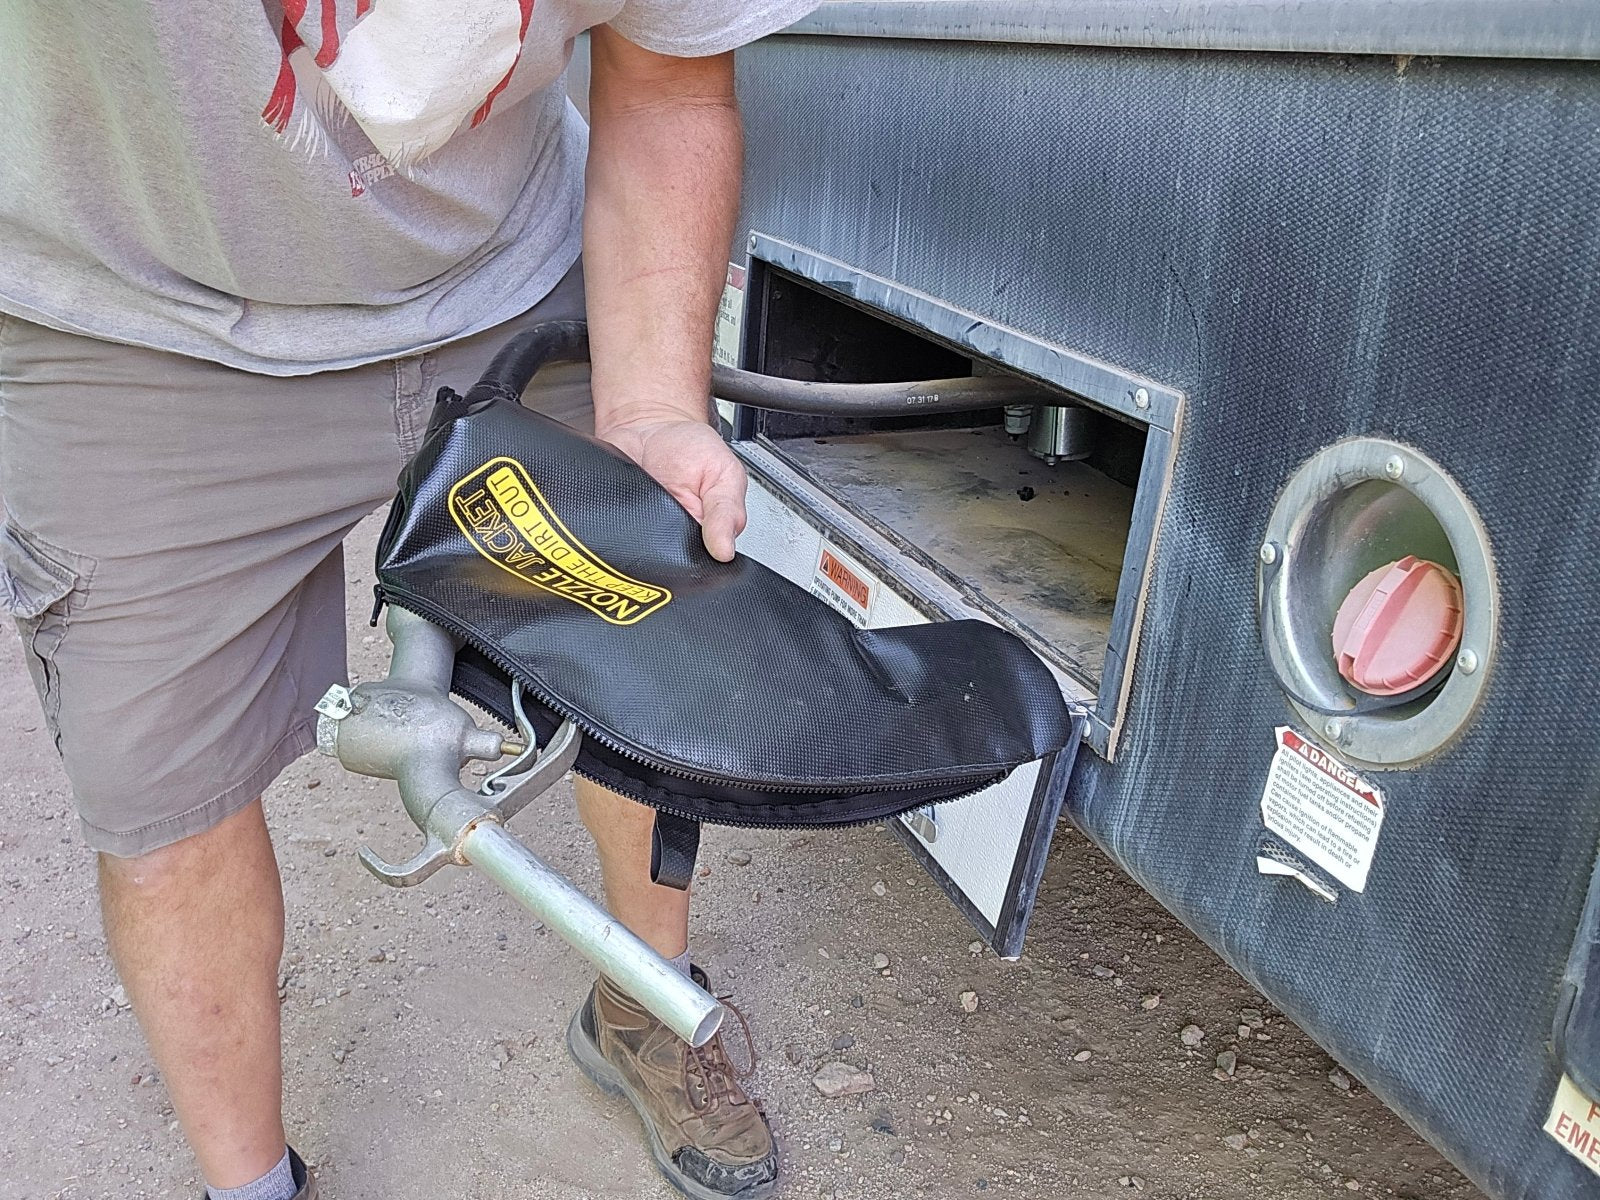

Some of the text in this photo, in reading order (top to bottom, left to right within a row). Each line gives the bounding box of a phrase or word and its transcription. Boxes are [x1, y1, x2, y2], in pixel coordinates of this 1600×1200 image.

[455, 489, 640, 620] NOZZLE JACKET
[490, 475, 658, 601] KEEP THE DIRT OUT
[830, 561, 867, 605] WARNING
[1277, 765, 1291, 777] shall
[1299, 780, 1317, 797] turned
[1326, 799, 1345, 815] before
[1279, 756, 1299, 774] igniters
[1312, 781, 1339, 803] operating
[1340, 798, 1377, 828] instructions)
[1281, 748, 1289, 757] All
[1289, 754, 1301, 767] pilot
[1320, 777, 1350, 800] appliances
[1351, 797, 1363, 808] and
[1364, 804, 1378, 818] their
[1282, 778, 1298, 791] motor
[1298, 789, 1309, 800] fuel
[1309, 797, 1325, 811] tanks
[1325, 809, 1345, 824] and/or
[1345, 822, 1370, 842] propane
[1267, 804, 1292, 825] explosion
[1293, 823, 1304, 835] and
[1304, 831, 1321, 847] result
[1327, 848, 1344, 864] death
[1271, 788, 1282, 799] Can
[1282, 797, 1298, 812] cause
[1299, 808, 1320, 827] ignition
[1328, 828, 1358, 854] flammable
[1289, 811, 1306, 826] which
[1306, 824, 1317, 834] can
[1318, 830, 1330, 843] lead
[1343, 848, 1353, 860] fire
